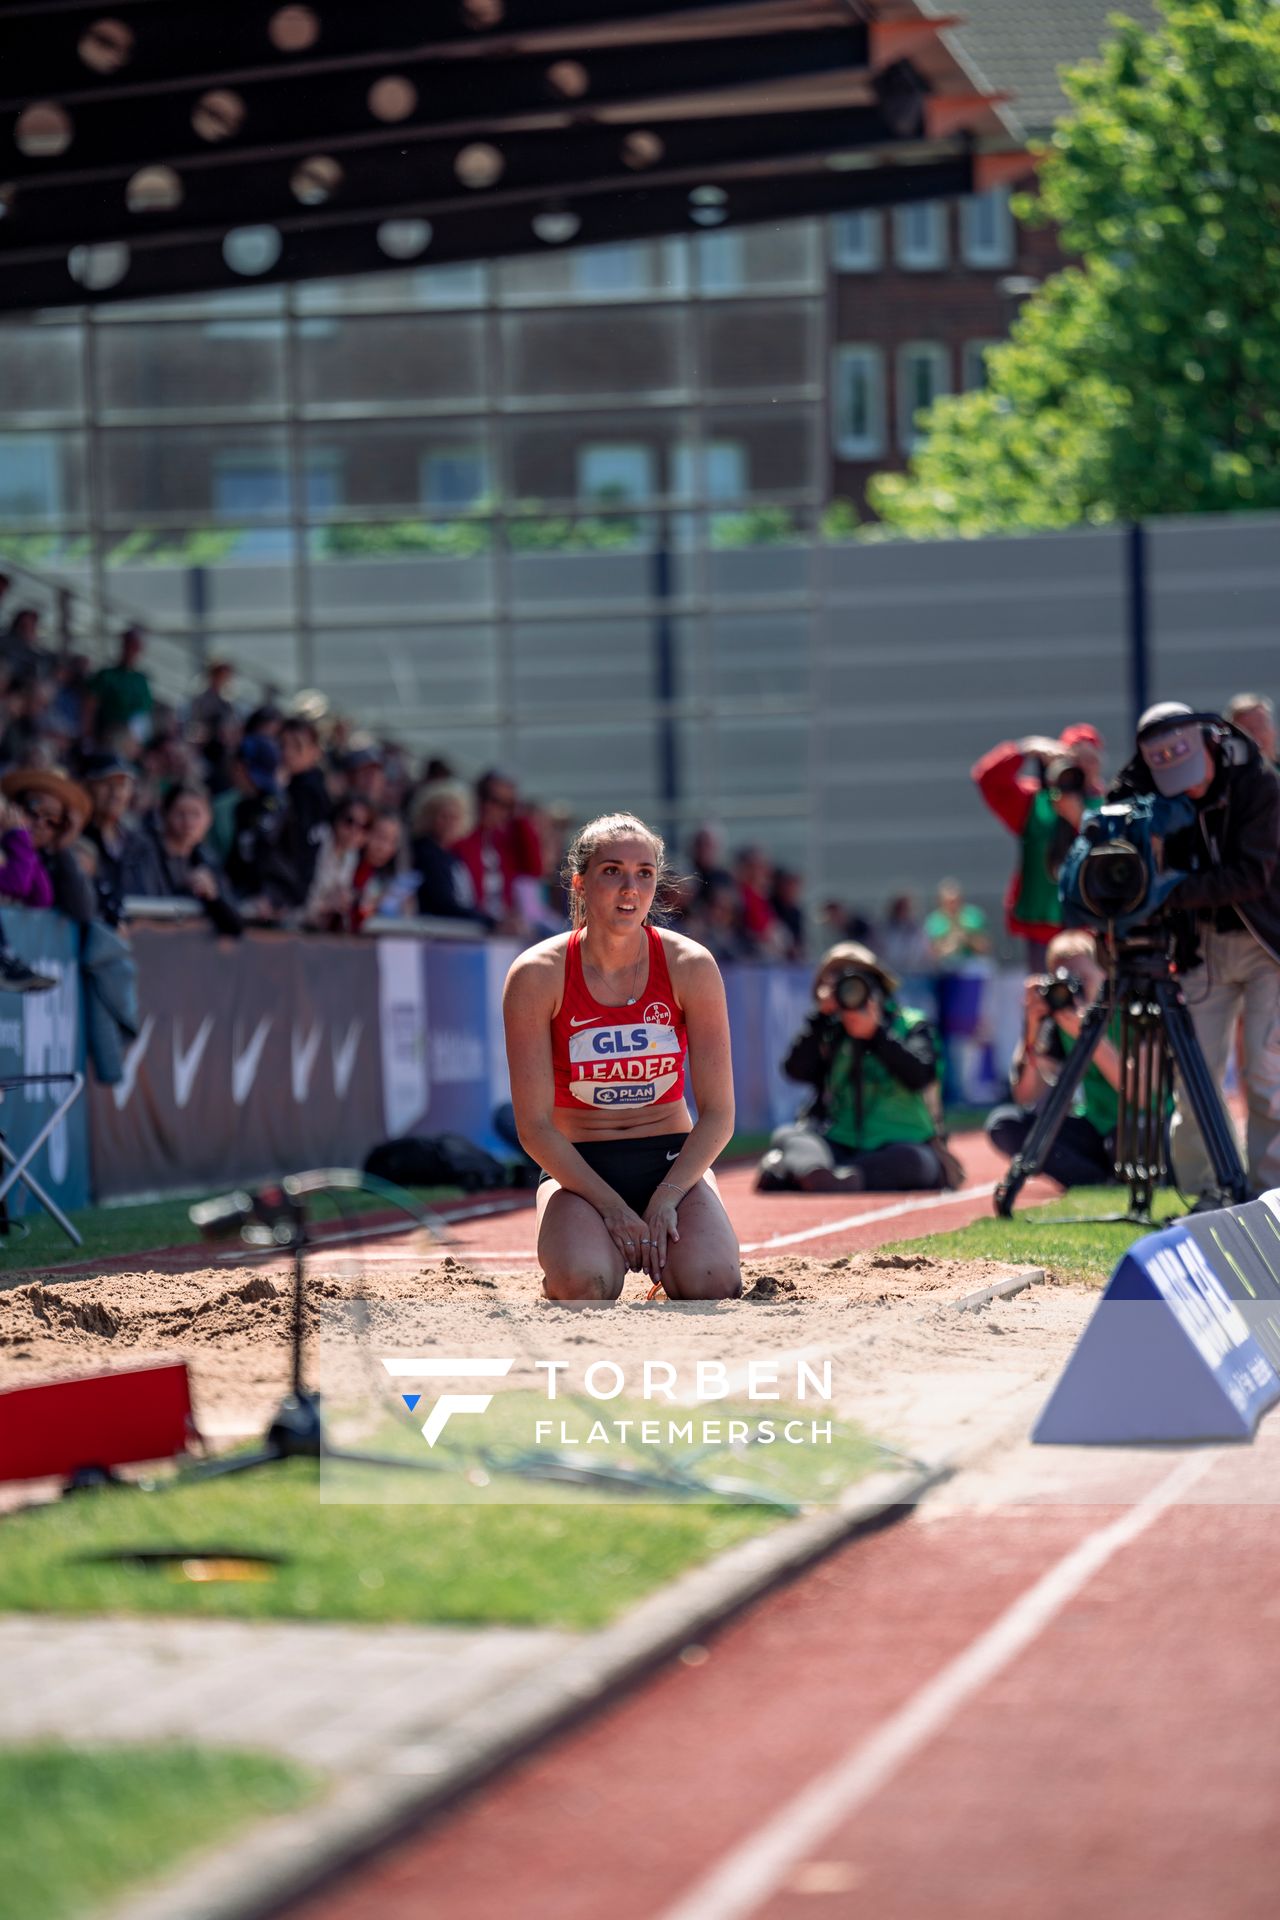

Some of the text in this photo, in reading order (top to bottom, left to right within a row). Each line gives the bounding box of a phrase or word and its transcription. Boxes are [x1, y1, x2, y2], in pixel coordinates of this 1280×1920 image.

[646, 1012, 669, 1022] BAYER
[578, 1056, 676, 1080] LEADER
[619, 1087, 653, 1098] PLAN
